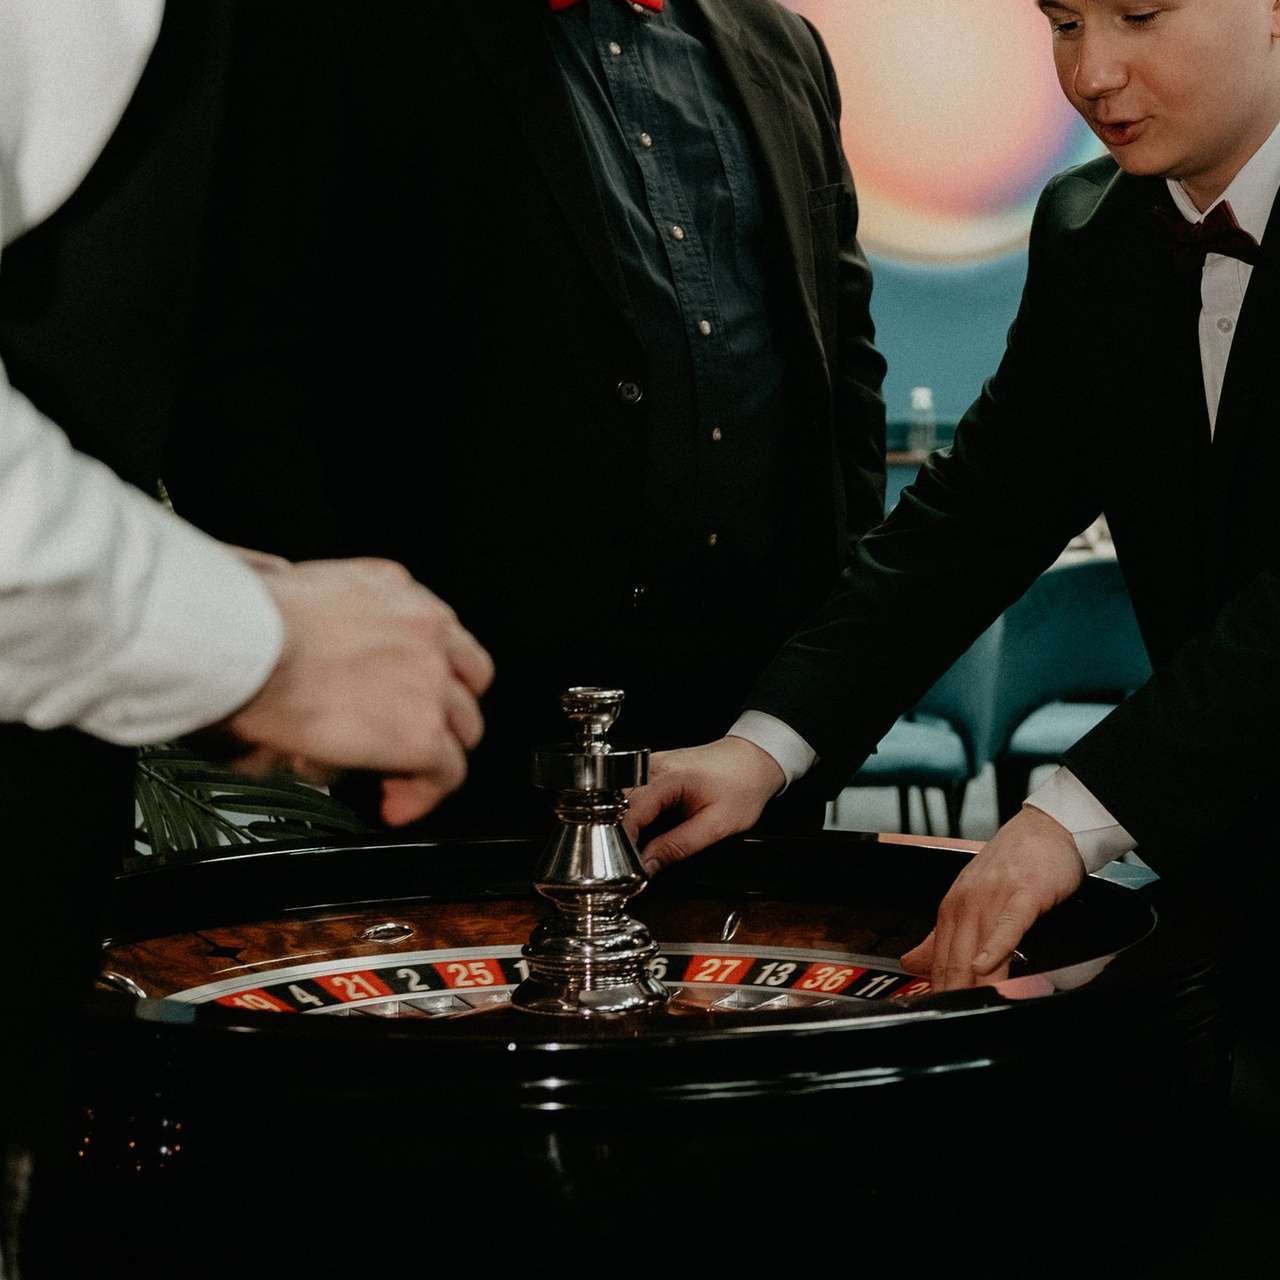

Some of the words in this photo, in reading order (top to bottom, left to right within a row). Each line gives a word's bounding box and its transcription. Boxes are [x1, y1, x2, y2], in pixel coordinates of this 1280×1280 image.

[397, 969, 430, 991] 2
[447, 962, 494, 987] 25
[513, 960, 530, 982] 1
[692, 959, 743, 982] 27
[754, 962, 797, 986] 13
[801, 967, 853, 991] 36
[288, 984, 324, 1007] 4
[331, 976, 381, 1000] 21
[855, 975, 898, 997] 11
